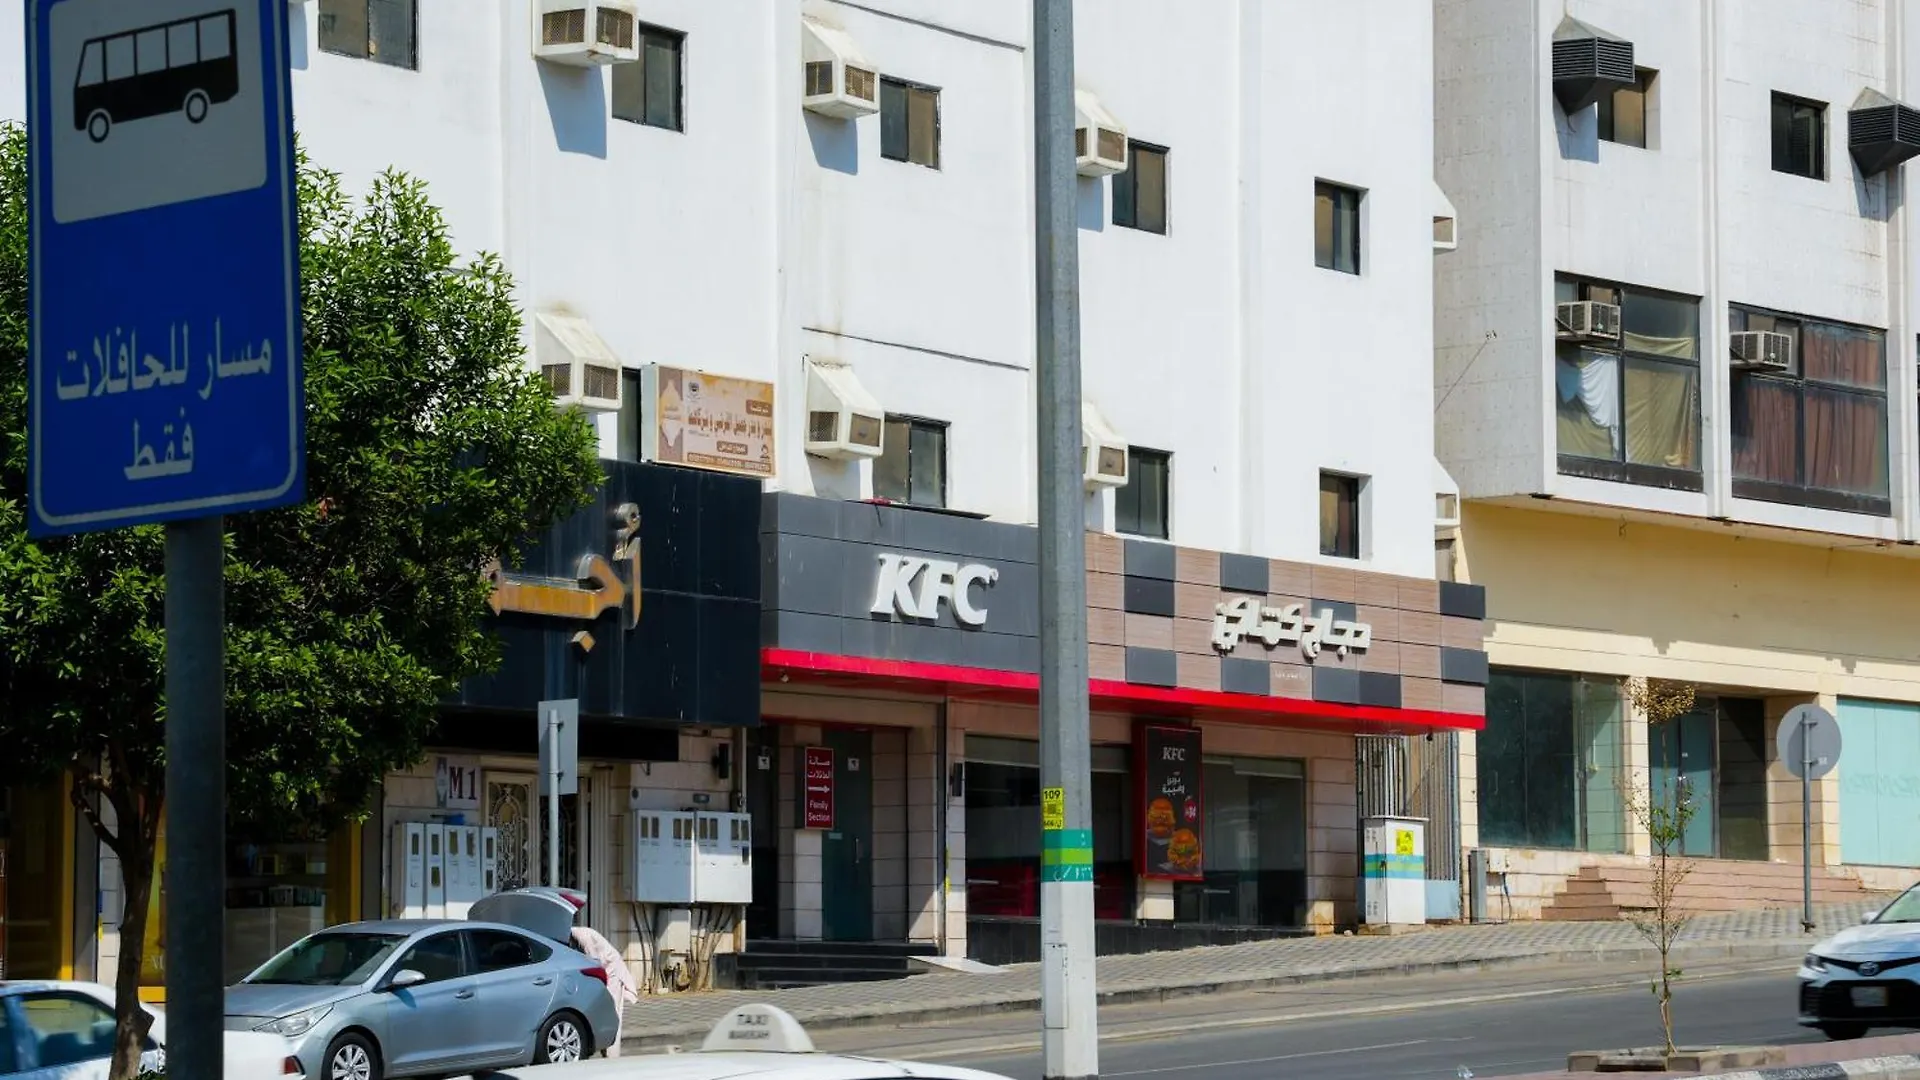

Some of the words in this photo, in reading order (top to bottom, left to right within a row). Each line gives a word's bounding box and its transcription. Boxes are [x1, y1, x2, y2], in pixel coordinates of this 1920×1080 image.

[56, 320, 189, 400] للحافلات
[198, 315, 272, 400] مسار
[123, 406, 194, 481] فقط
[870, 553, 991, 626] KFC
[1212, 597, 1304, 651] كنتاكي
[1162, 747, 1185, 761] KFC
[449, 766, 476, 800] M1
[1044, 790, 1061, 799] 109
[808, 812, 831, 822] Section
[810, 800, 828, 811] Family
[737, 1013, 769, 1026] TAXI
